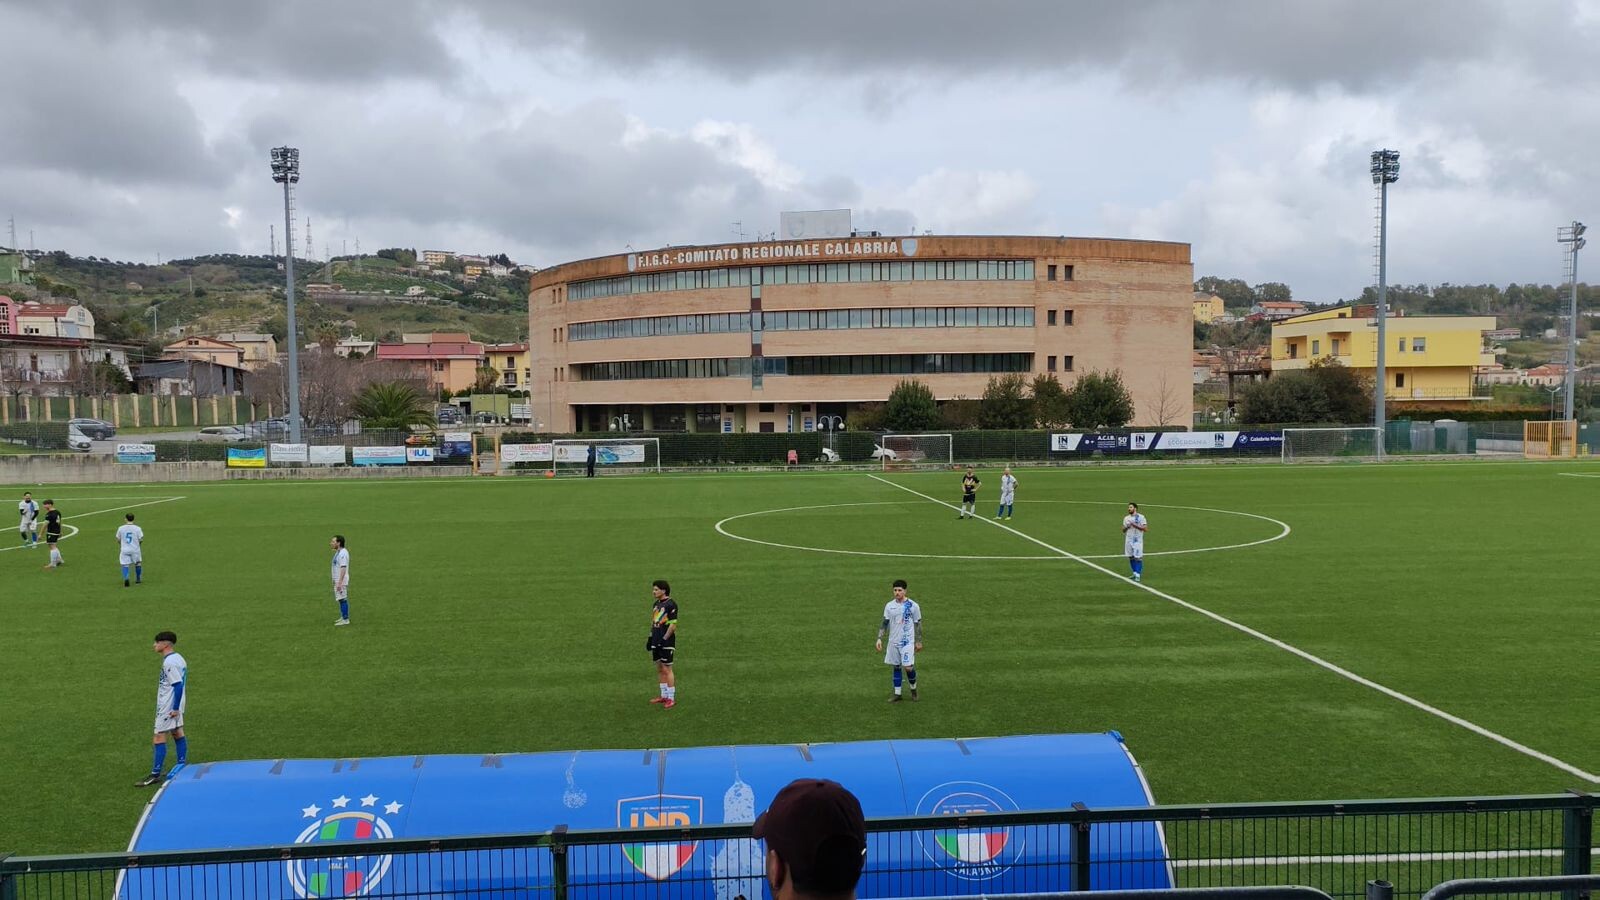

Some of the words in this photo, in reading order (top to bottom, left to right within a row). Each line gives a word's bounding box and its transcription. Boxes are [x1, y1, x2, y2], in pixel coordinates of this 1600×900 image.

[743, 243, 820, 259] REGIONALE
[824, 241, 898, 255] CALABRIA
[126, 532, 133, 544] 5
